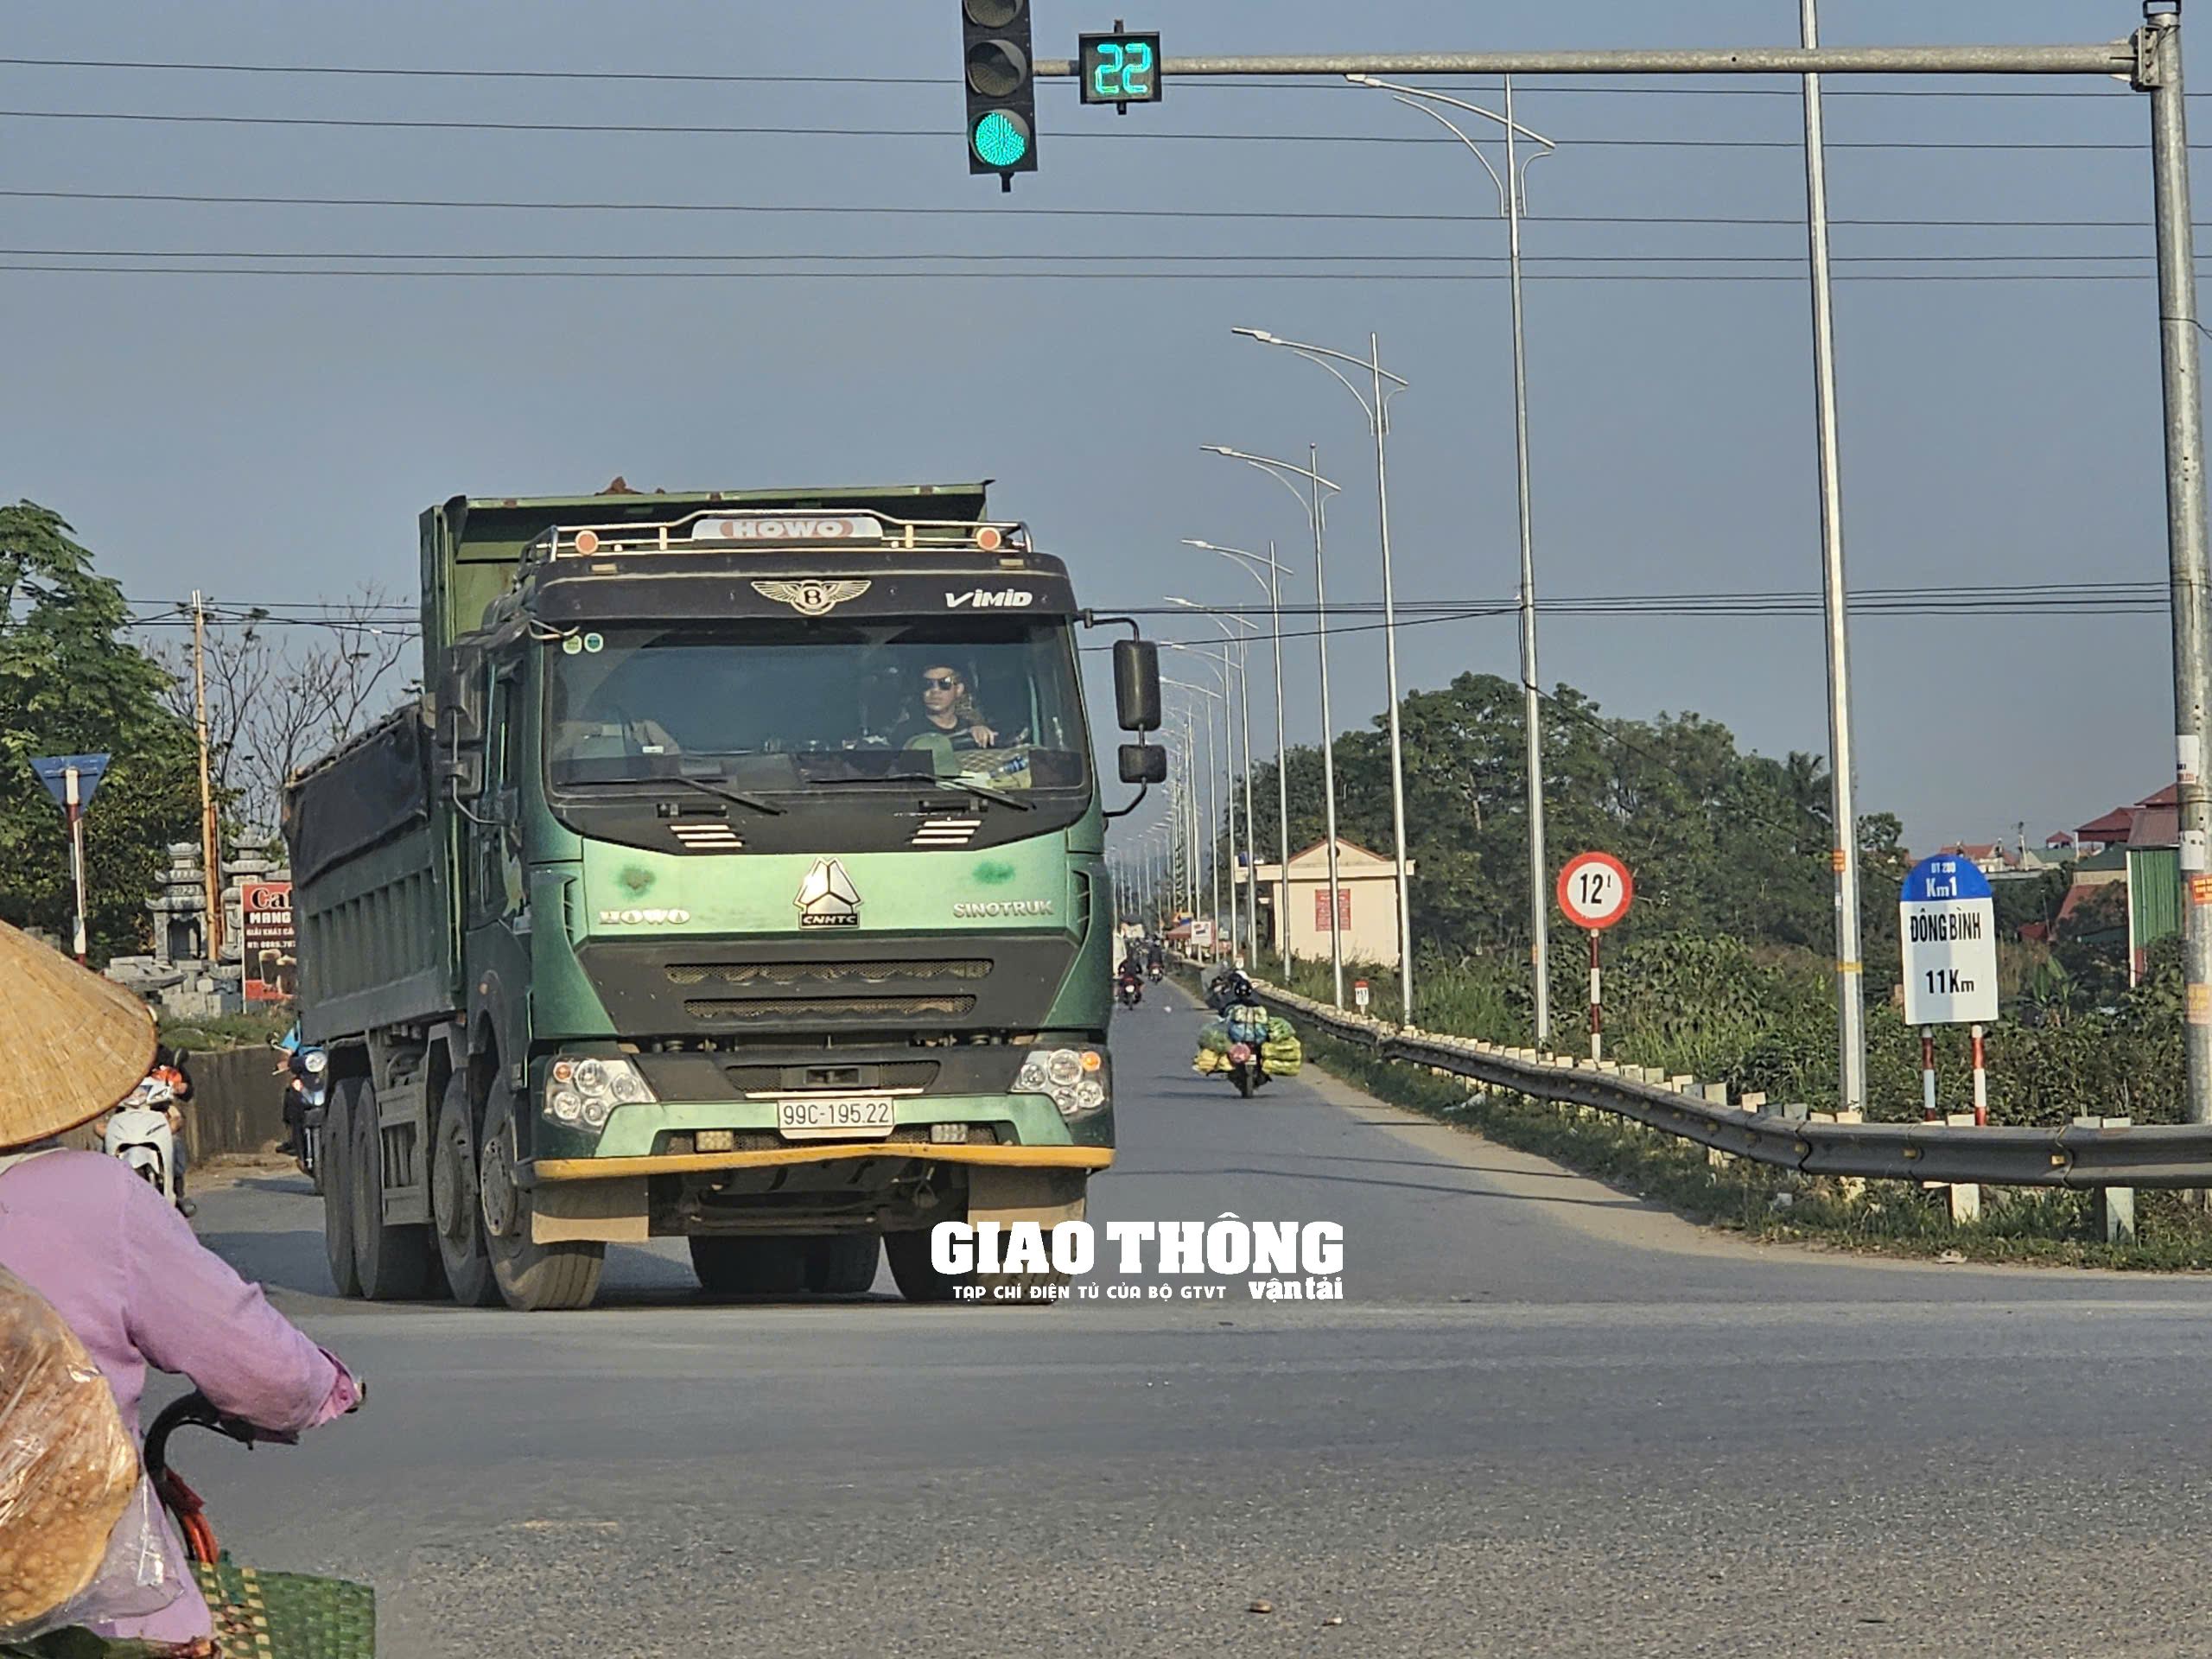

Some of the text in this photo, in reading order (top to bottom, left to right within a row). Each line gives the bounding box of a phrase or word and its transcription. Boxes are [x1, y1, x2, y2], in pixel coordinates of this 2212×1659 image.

[1095, 43, 1143, 94] 22
[733, 520, 843, 537] HOWO
[599, 909, 690, 925] HOWO
[953, 899, 1053, 918] SINOTRUK
[1949, 907, 1980, 940] BÌNH
[783, 1103, 889, 1125] 99C-195.22
